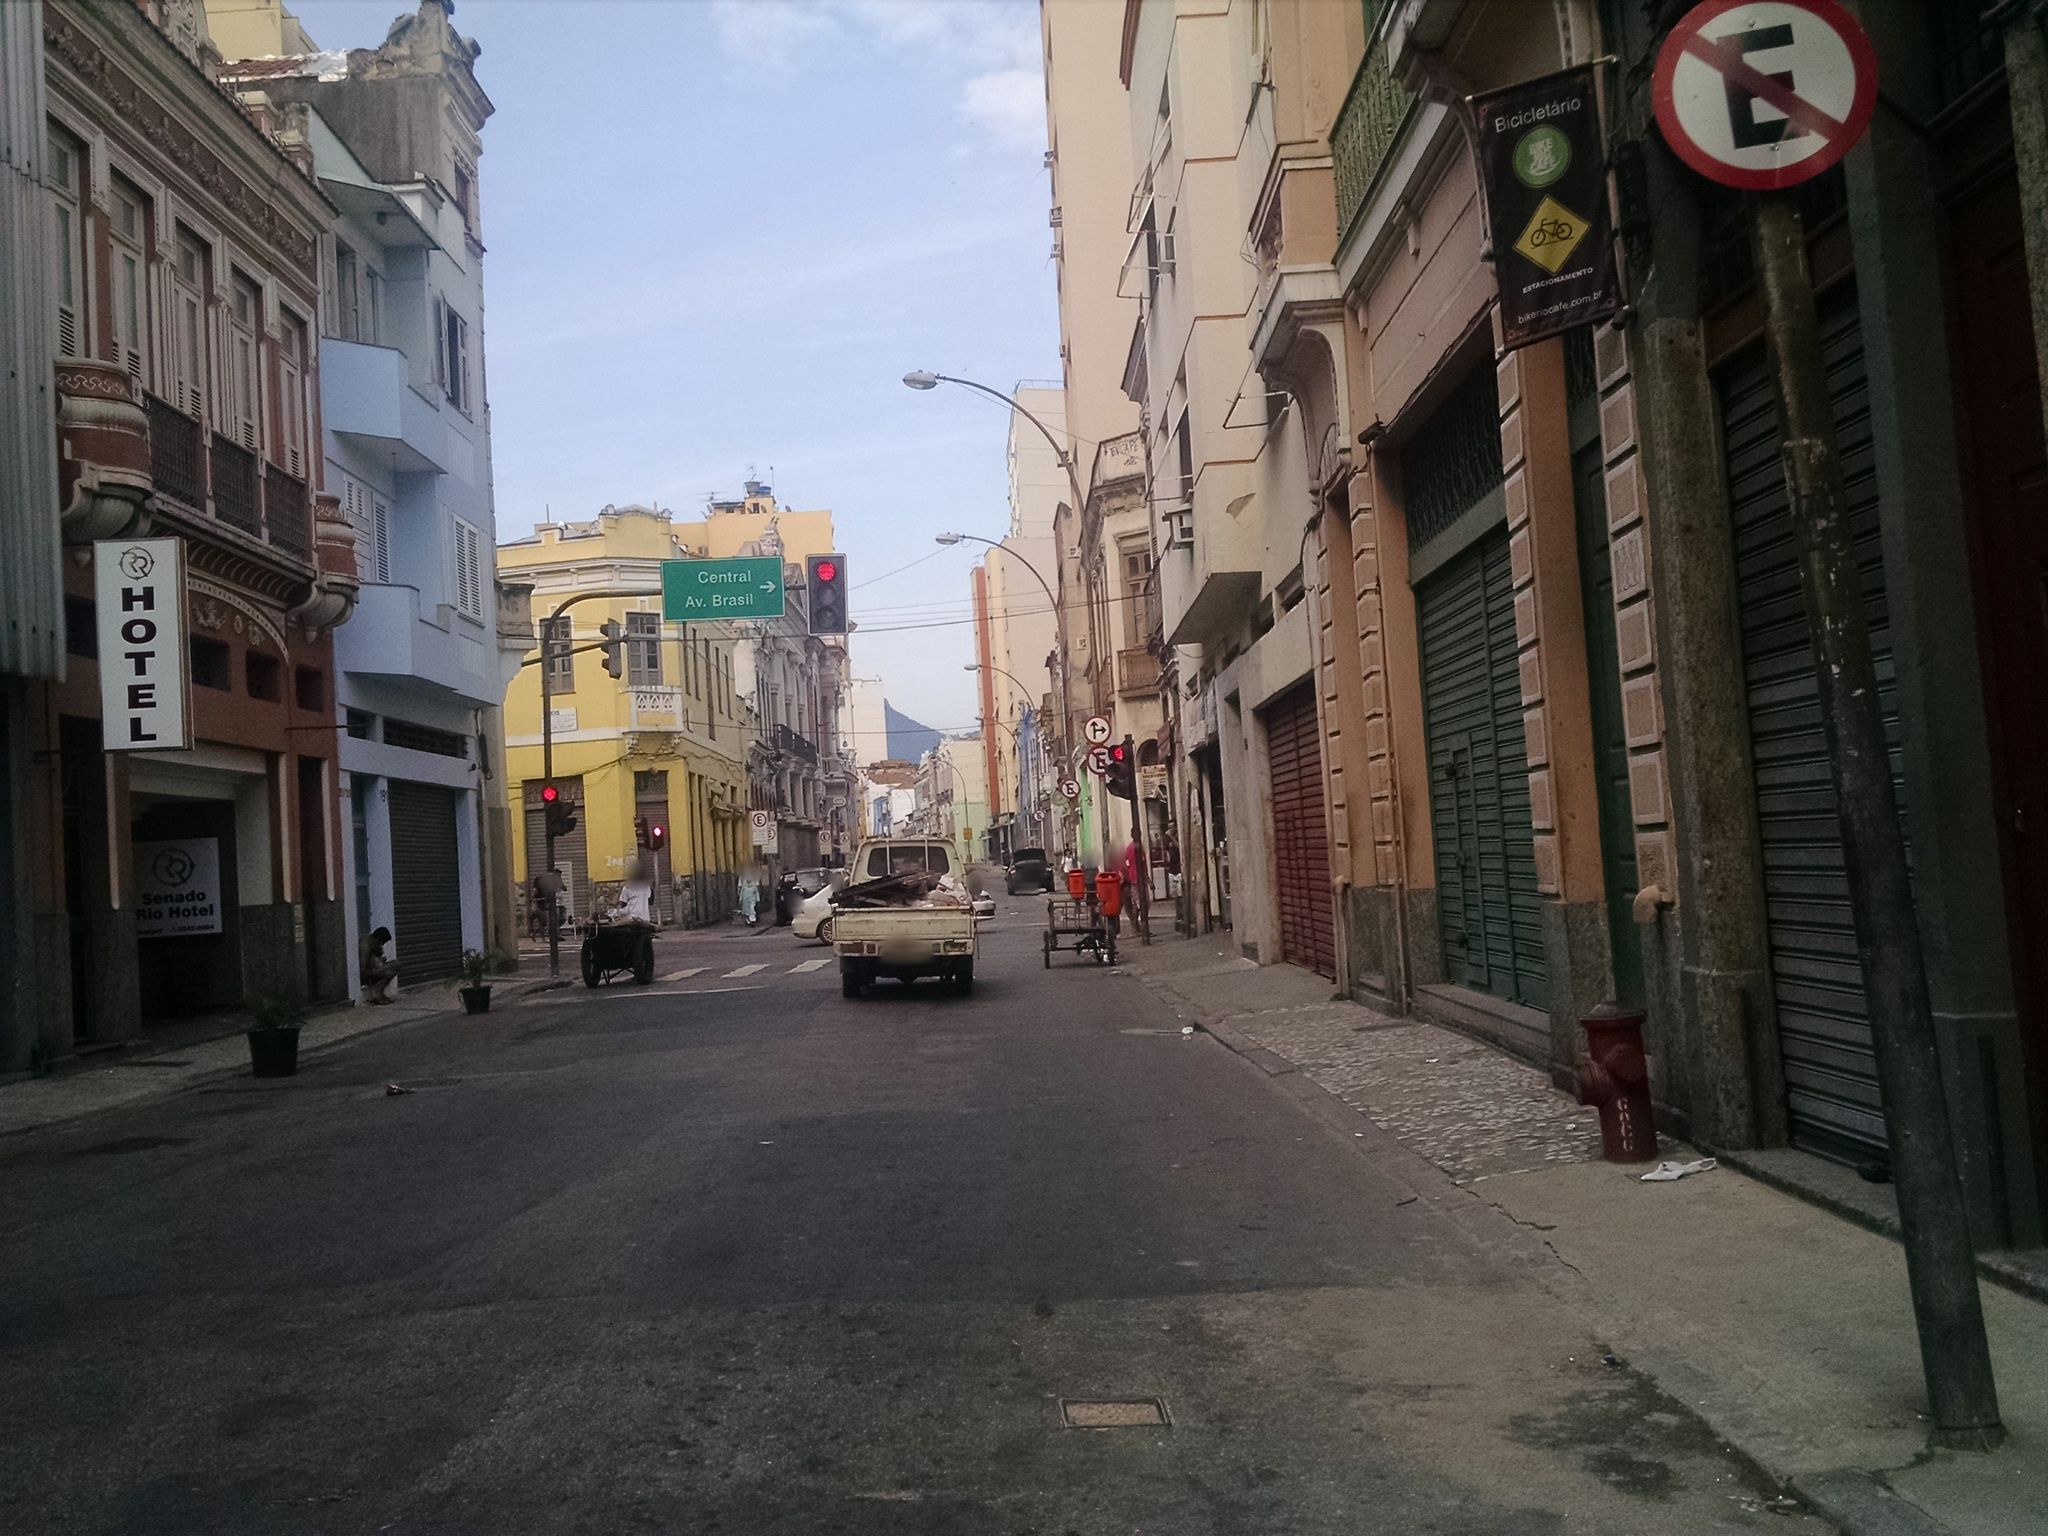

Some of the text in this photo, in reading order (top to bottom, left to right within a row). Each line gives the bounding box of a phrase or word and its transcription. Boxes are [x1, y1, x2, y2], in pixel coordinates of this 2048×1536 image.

[1717, 23, 1810, 149] E
[1495, 97, 1581, 133] Bicicletário
[1522, 267, 1593, 294] ESTACIONAMENTO
[1518, 290, 1602, 324] bikeriocafe.com.br
[697, 570, 751, 584] Central
[685, 593, 753, 608] Av. Brasil
[121, 586, 157, 742] HOTEL
[757, 815, 763, 824] E
[142, 889, 206, 905] Senado
[136, 904, 214, 920] Rio Hotel
